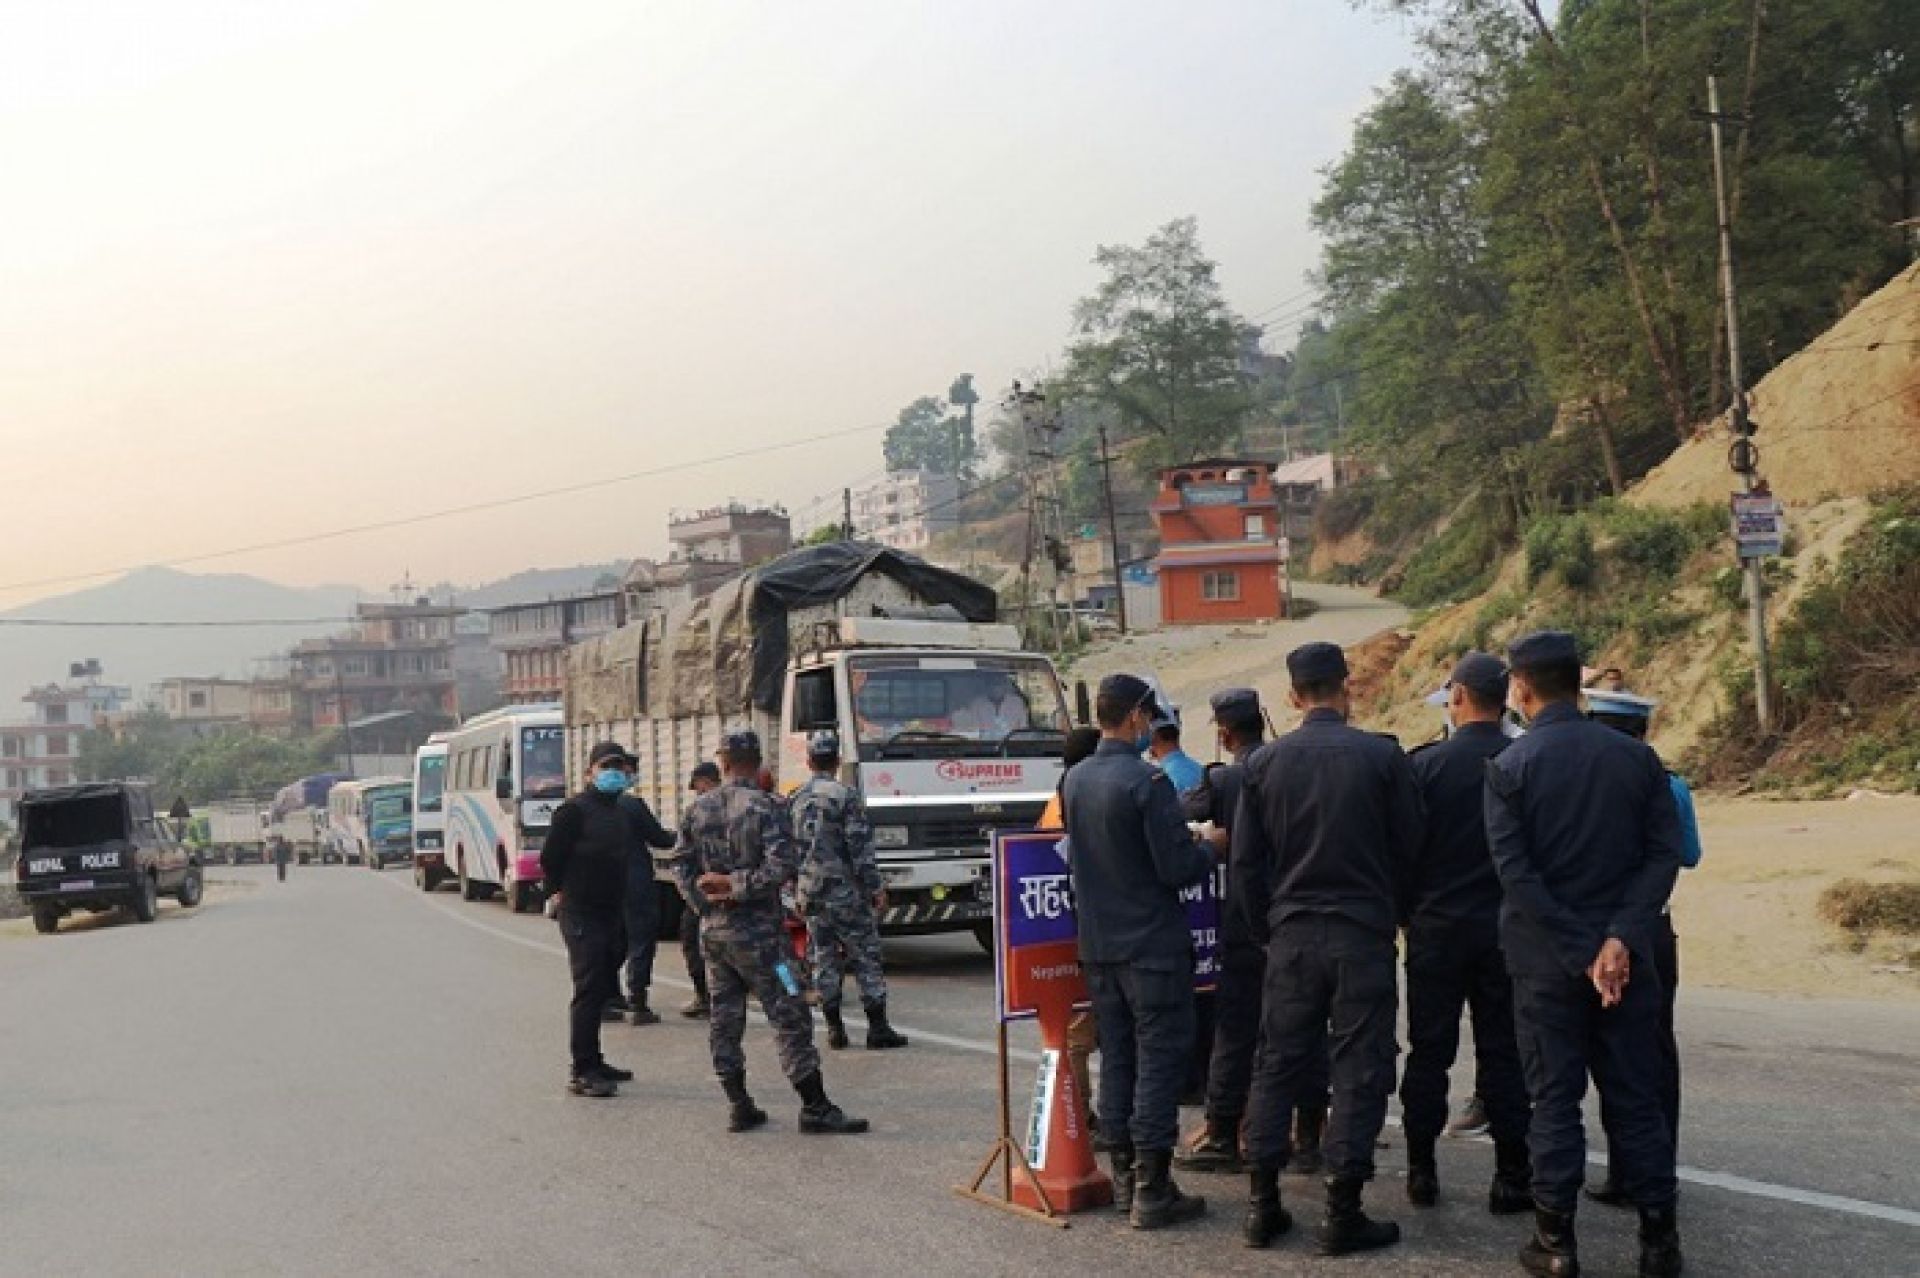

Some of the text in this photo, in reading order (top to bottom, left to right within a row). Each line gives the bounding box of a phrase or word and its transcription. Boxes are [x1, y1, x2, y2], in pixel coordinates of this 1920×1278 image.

[959, 764, 1023, 779] SUPREME
[29, 852, 120, 875] NEPAL POLICE
